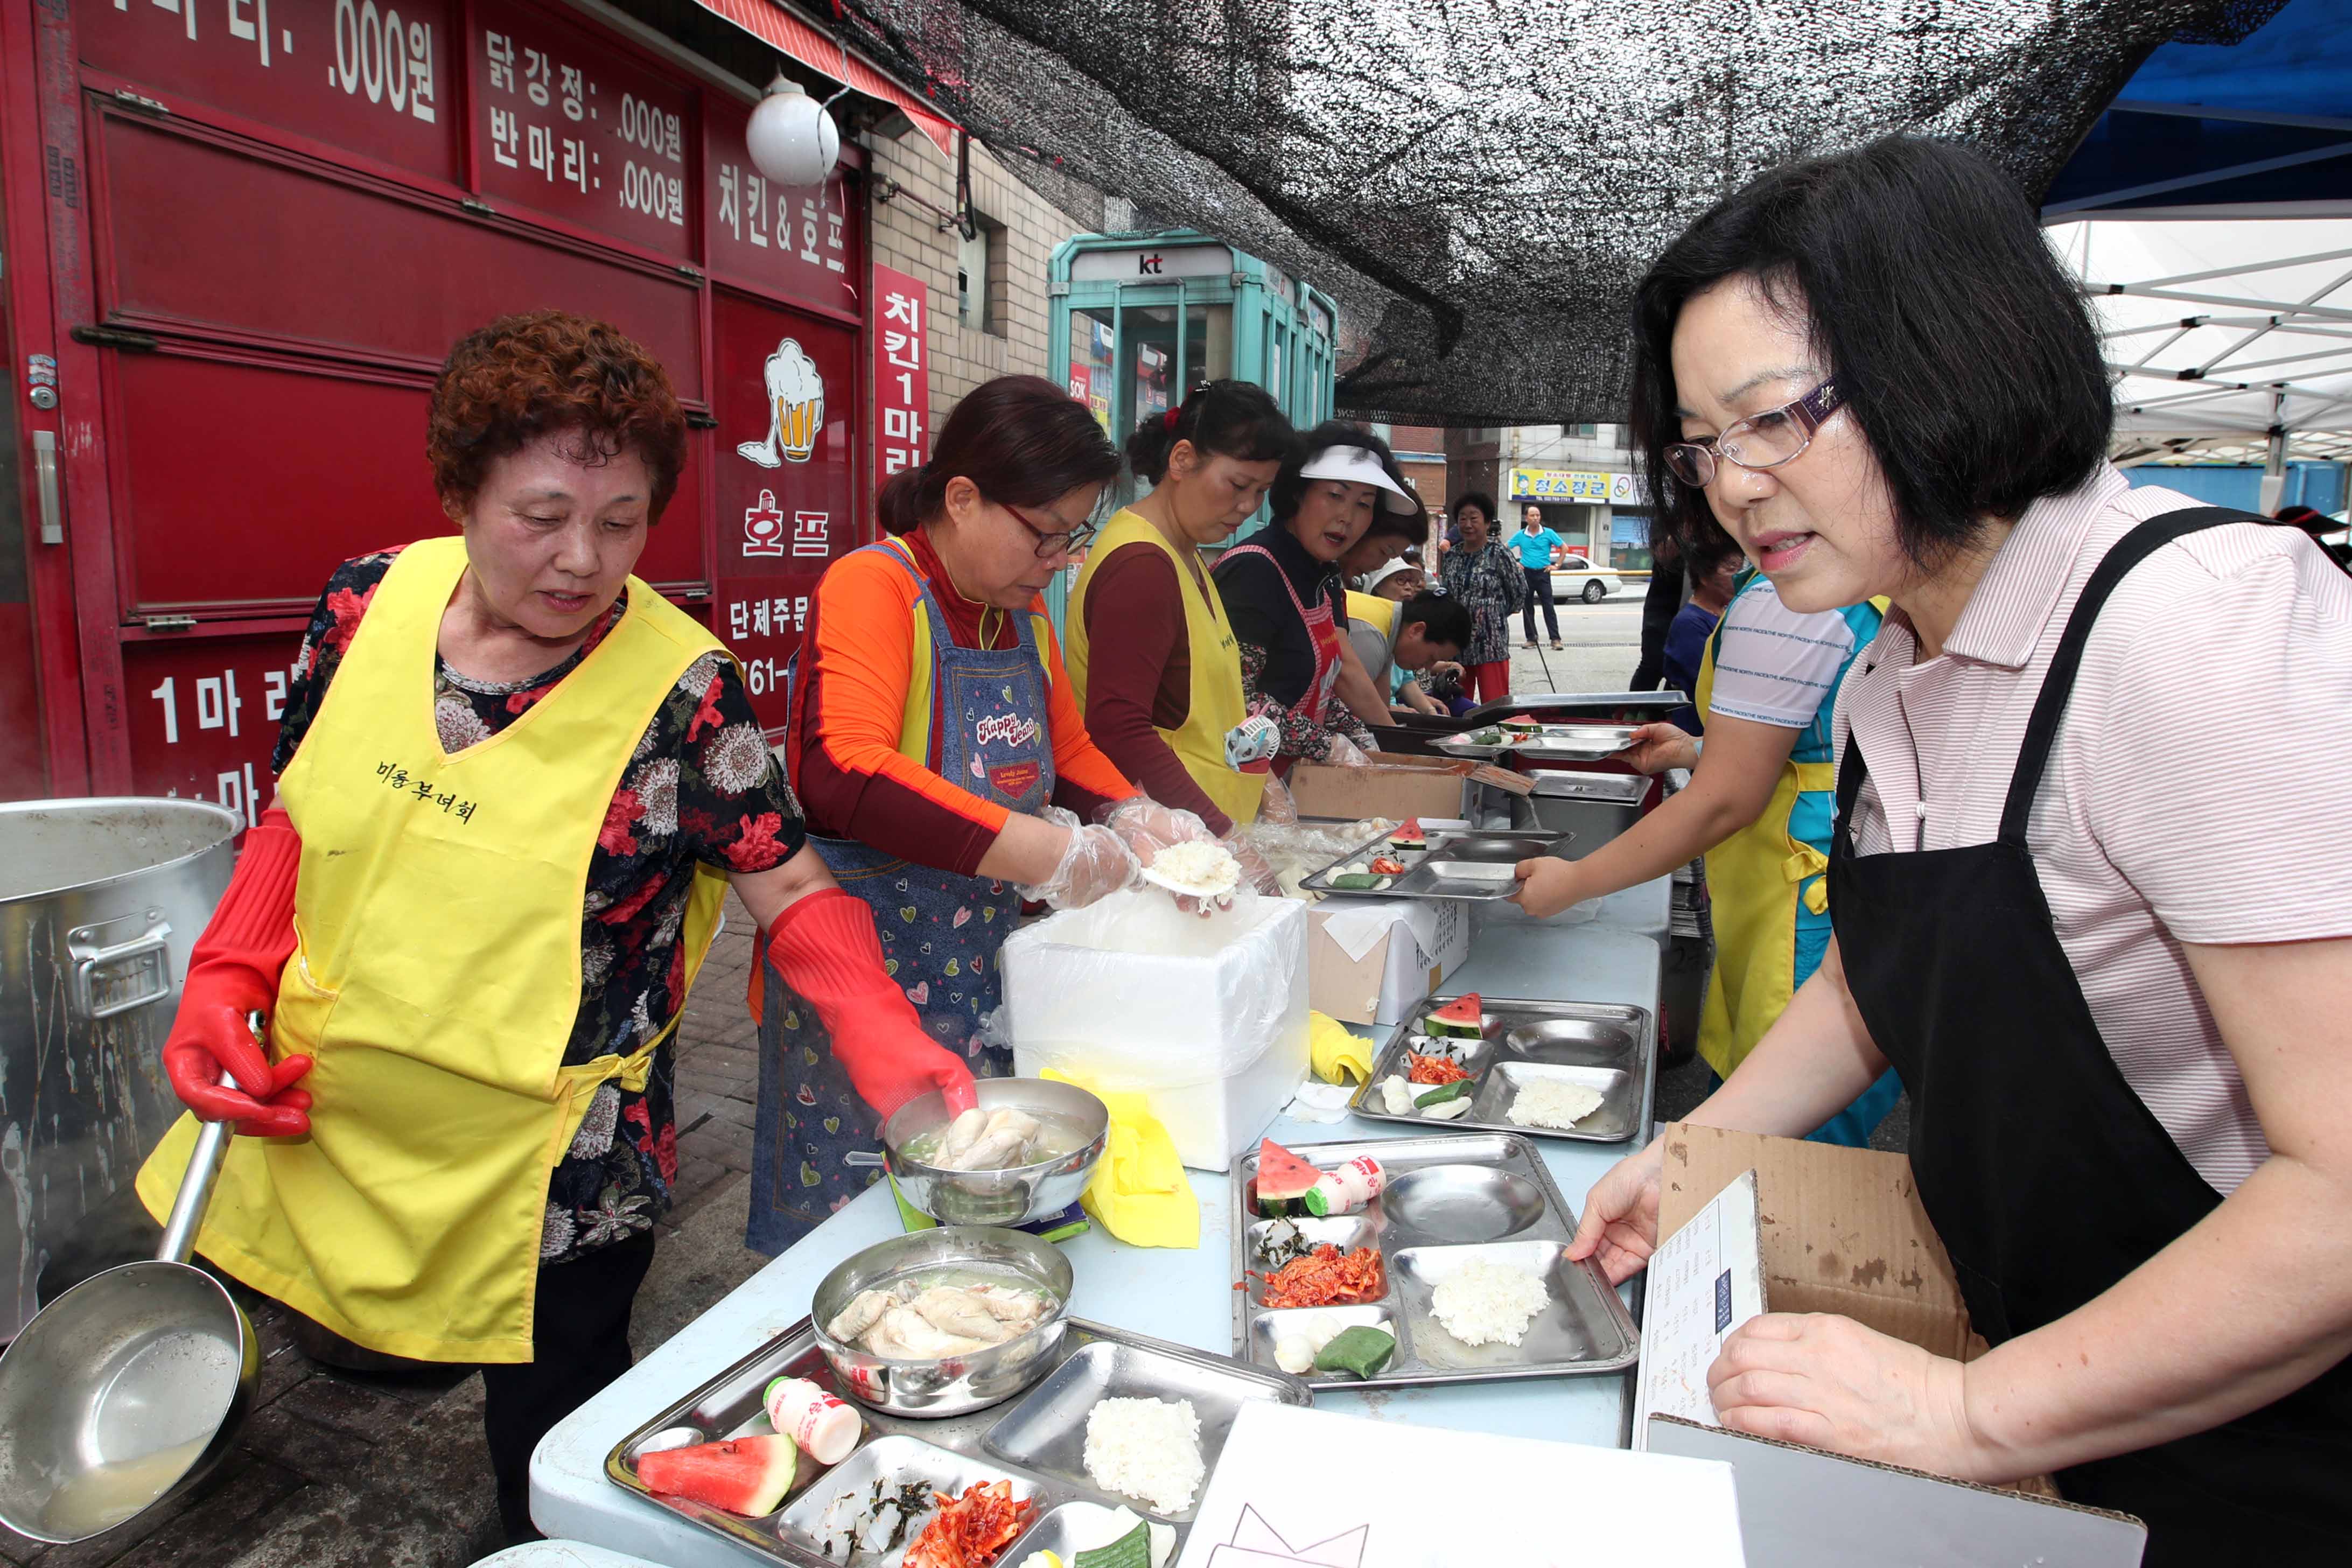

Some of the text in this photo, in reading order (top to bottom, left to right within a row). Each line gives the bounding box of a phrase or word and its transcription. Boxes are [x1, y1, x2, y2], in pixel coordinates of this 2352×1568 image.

[1139, 254, 1163, 275] kt
[1535, 479, 1606, 495] 청소장군
[743, 489, 829, 557] 호프
[977, 712, 1035, 747] Happy Jeans
